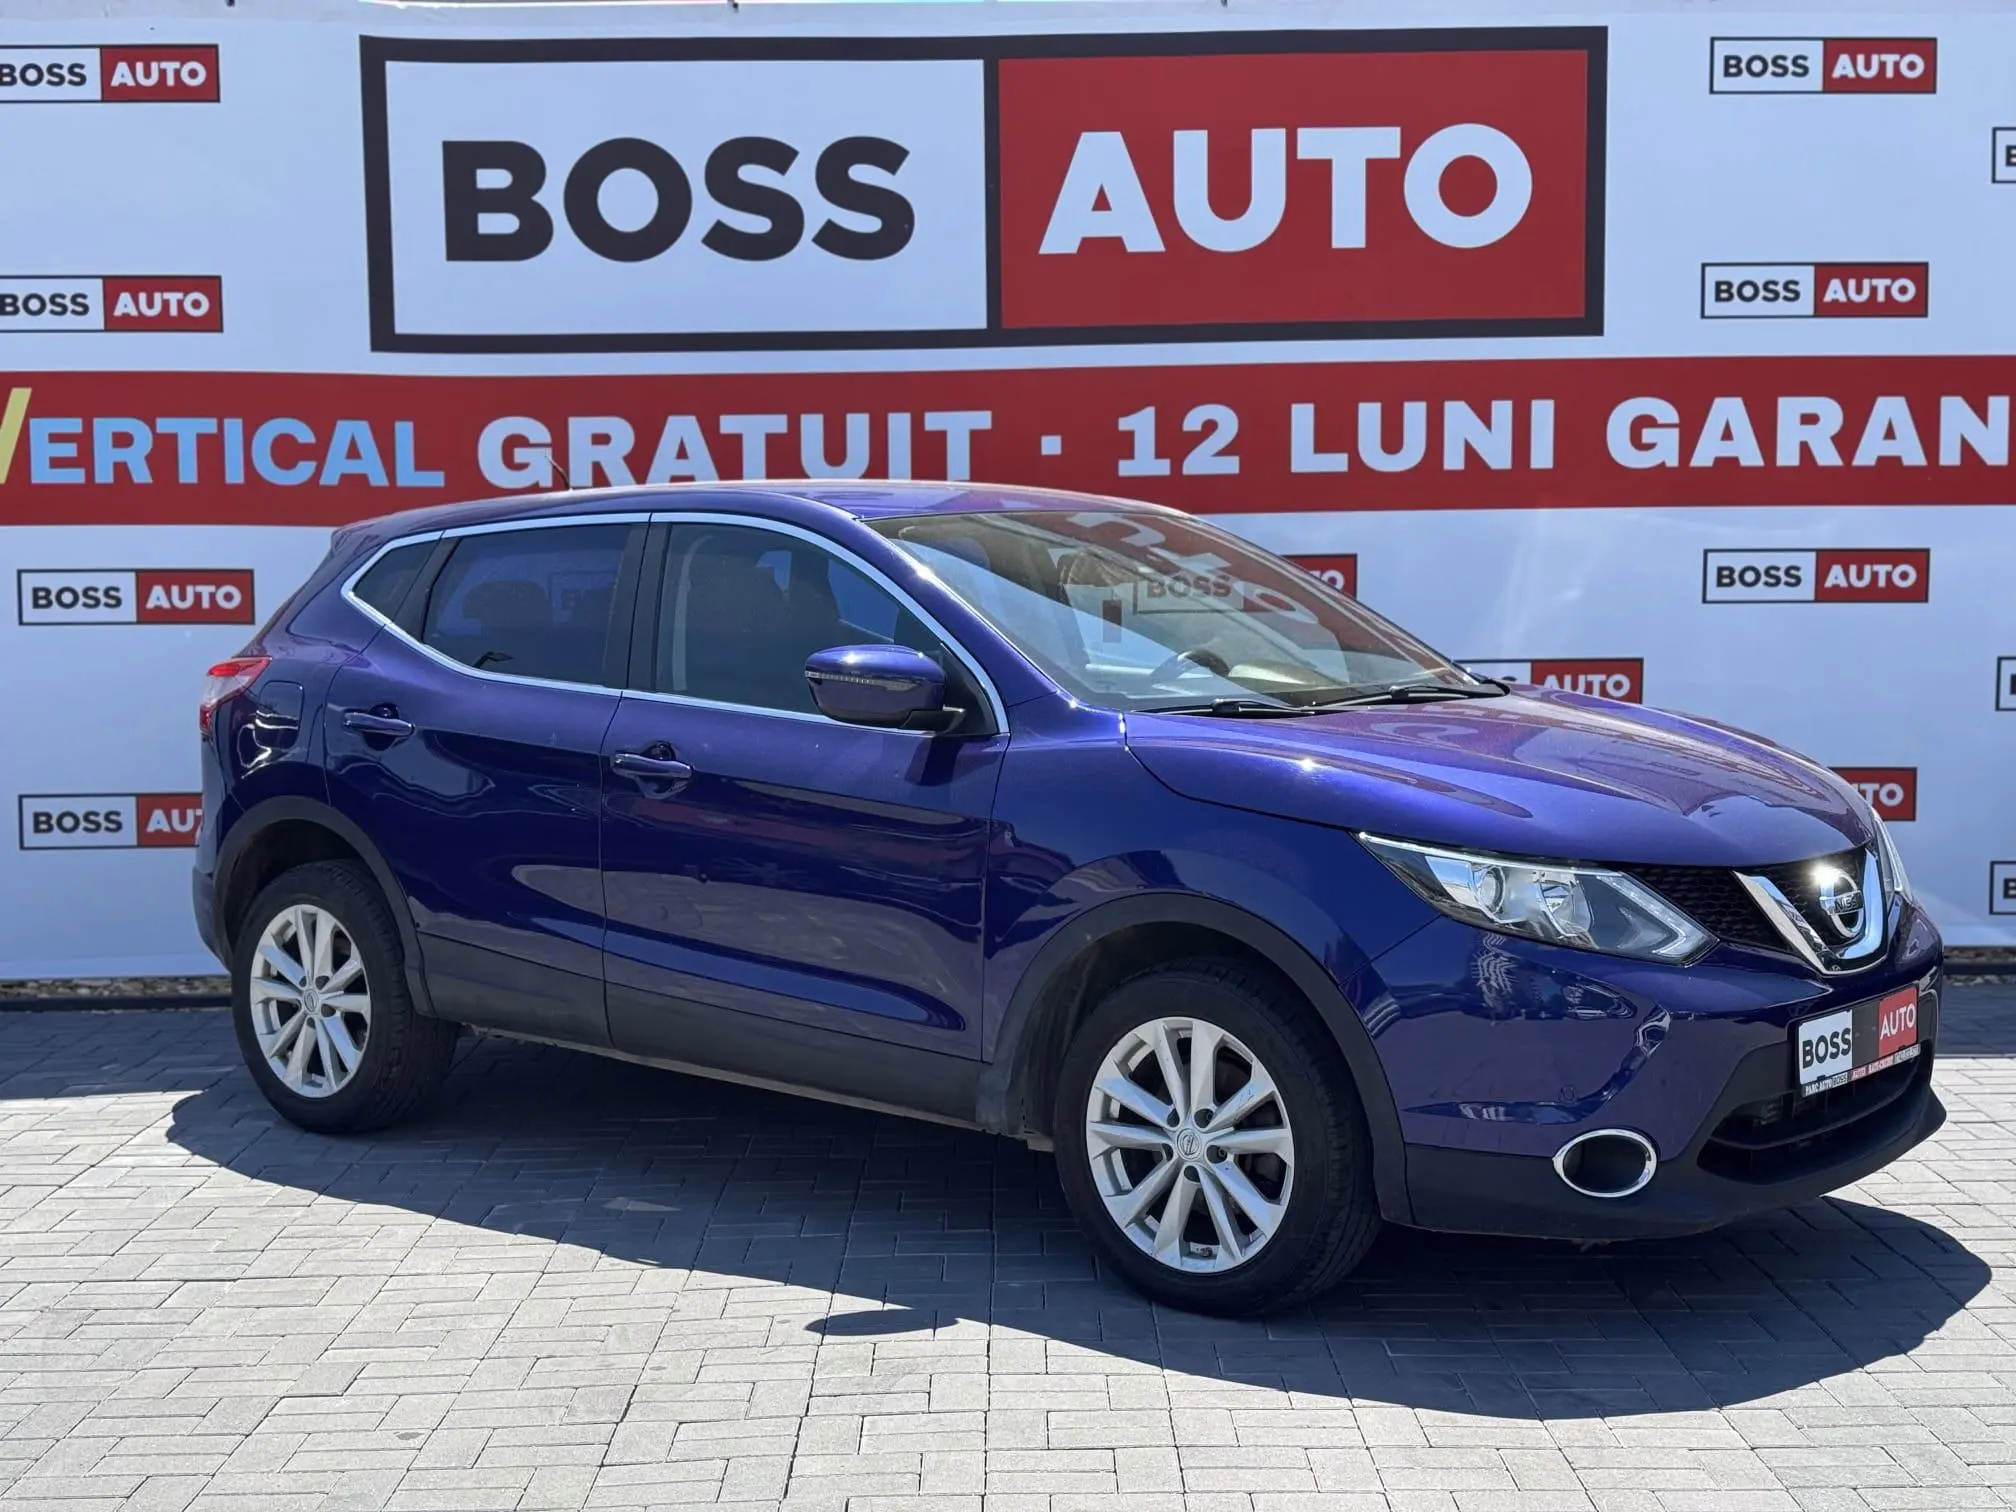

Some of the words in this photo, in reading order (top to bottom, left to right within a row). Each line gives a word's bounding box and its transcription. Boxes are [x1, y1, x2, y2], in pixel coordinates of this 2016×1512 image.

[0, 63, 87, 87] BOSS
[110, 61, 207, 87] AUTO
[1722, 54, 1810, 78] BOSS
[1832, 53, 1926, 79] AUTO
[442, 135, 915, 262] BOSS
[1038, 122, 1533, 254] AUTO
[1713, 279, 1802, 303] BOSS
[1823, 277, 1917, 303] AUTO
[0, 293, 90, 317] BOSS
[113, 291, 210, 317] AUTO
[477, 410, 992, 488] GRATUIT
[1117, 403, 1240, 477] 12
[1290, 399, 1555, 472] LUNI
[1606, 396, 2010, 468] GARAN
[1715, 565, 1802, 588] BOSS
[1824, 564, 1918, 588] AUTO
[31, 586, 123, 609] BOSS
[146, 584, 242, 610] AUTO
[1543, 673, 1631, 698] AUTO
[33, 810, 123, 833] BOSS
[1802, 1027, 1852, 1069] BOSS
[1880, 1003, 1916, 1040] AUTO
